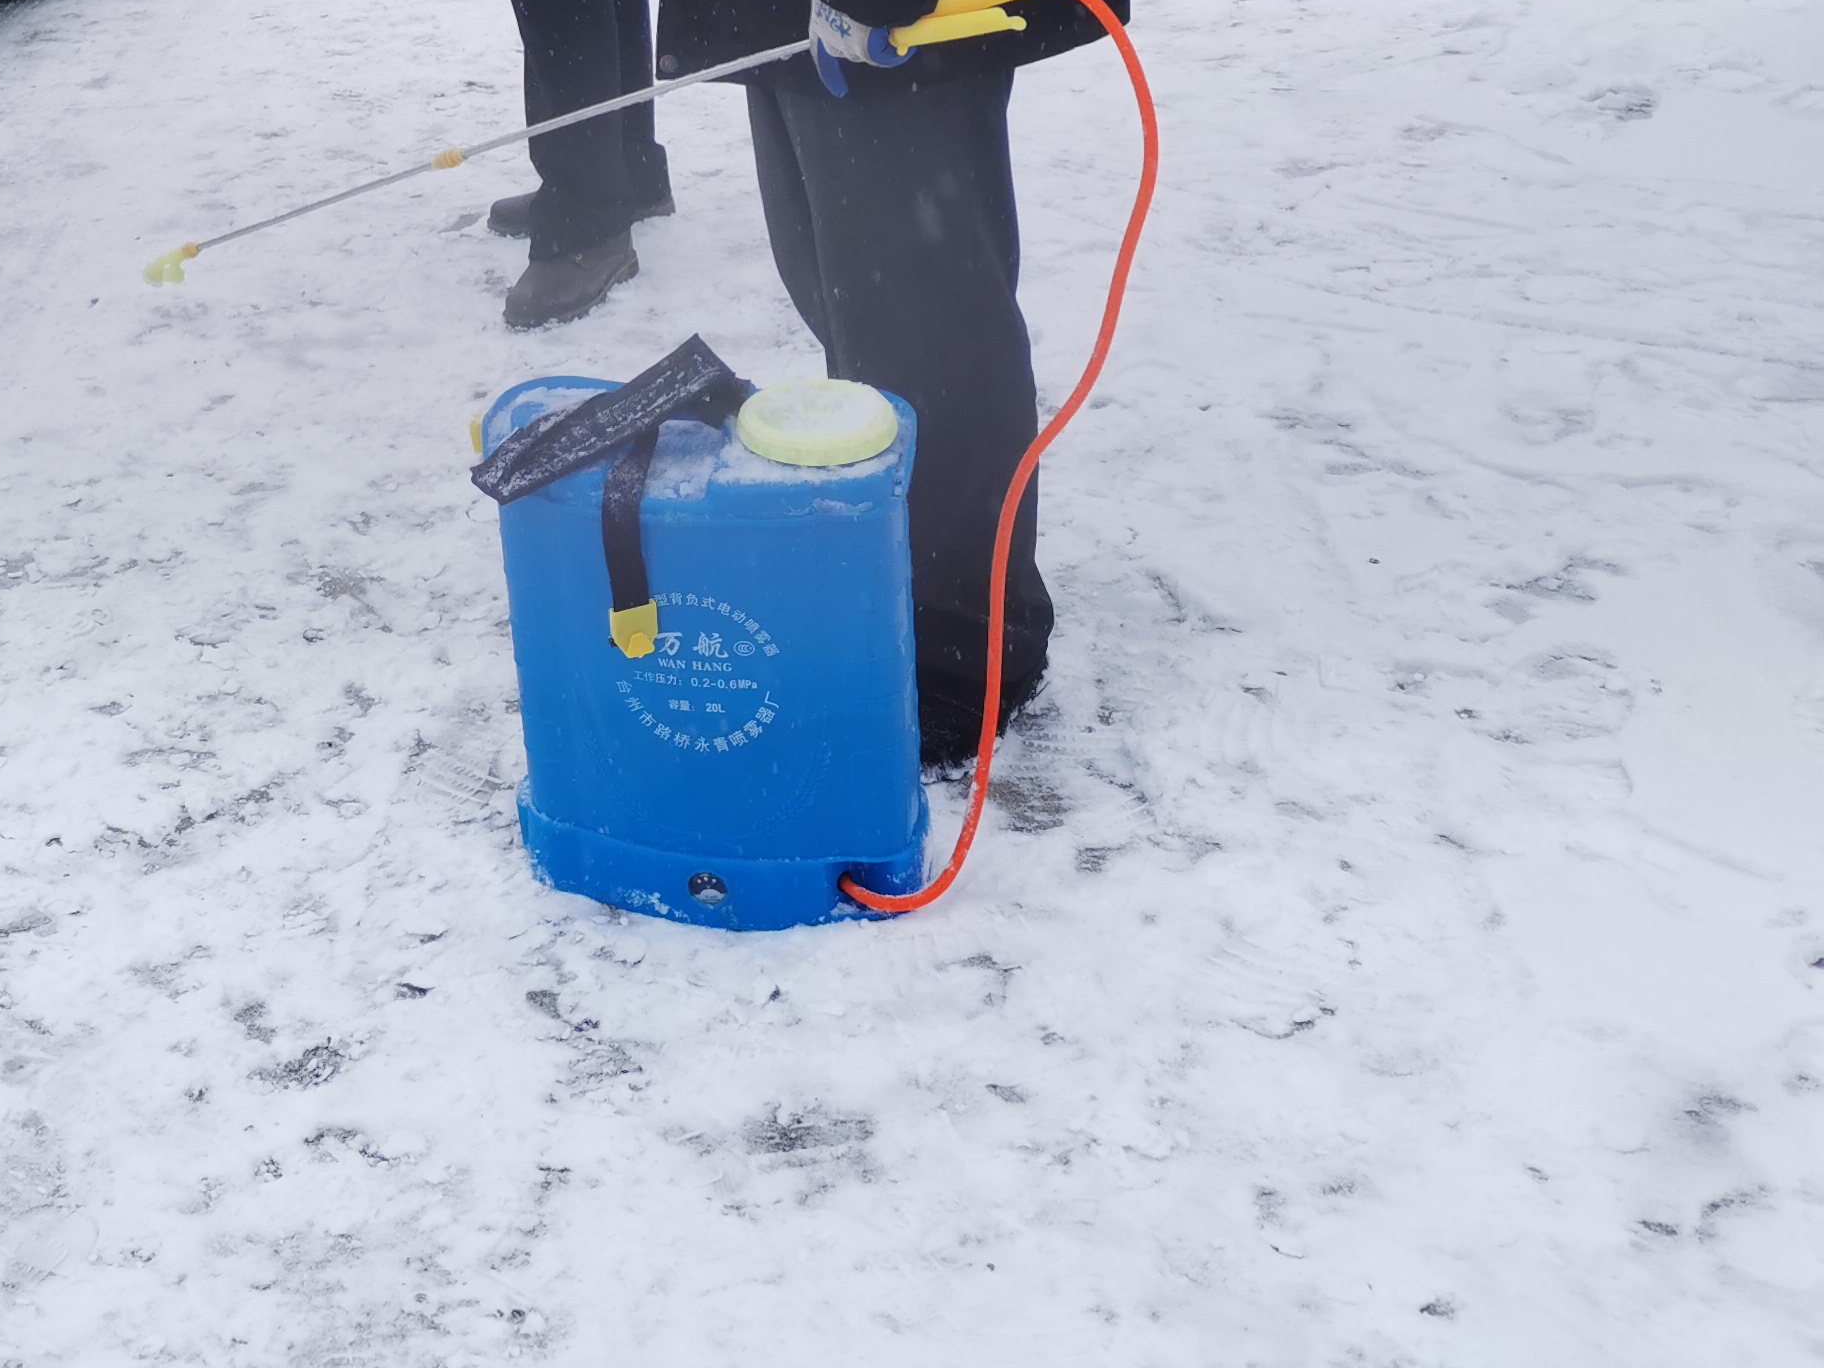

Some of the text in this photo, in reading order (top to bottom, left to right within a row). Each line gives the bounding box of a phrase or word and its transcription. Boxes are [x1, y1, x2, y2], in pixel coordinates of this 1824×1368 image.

[658, 658, 733, 672] WAN HANG
[690, 677, 758, 690] 0.2-0.6MPa
[705, 702, 726, 713] 20L
